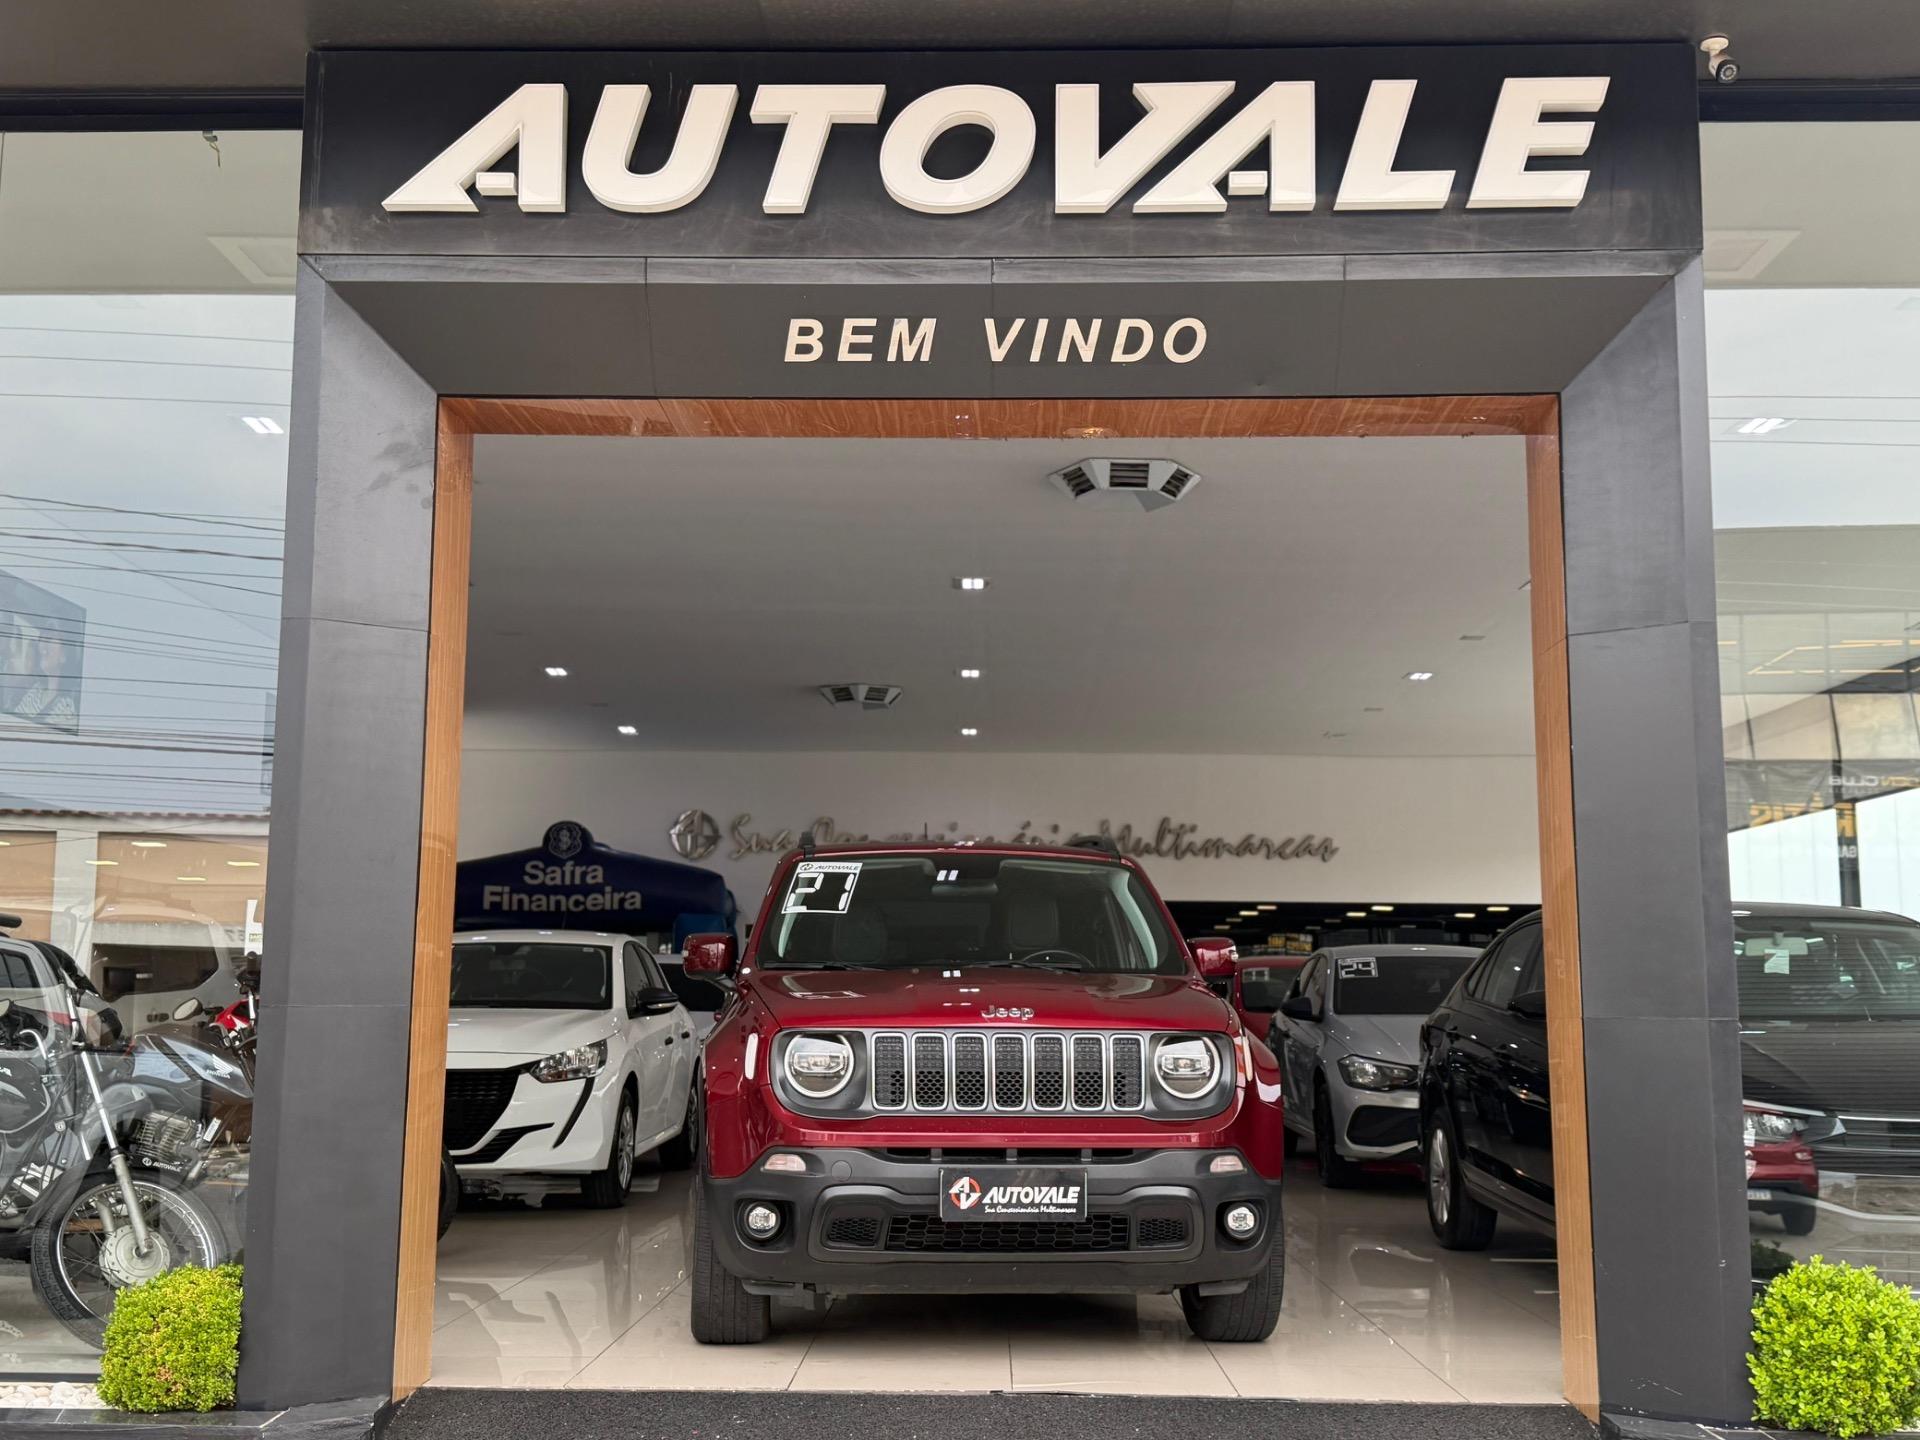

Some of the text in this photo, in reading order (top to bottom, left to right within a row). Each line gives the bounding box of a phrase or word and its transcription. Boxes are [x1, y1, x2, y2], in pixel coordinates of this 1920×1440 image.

[381, 77, 1610, 215] AUTOVALE
[784, 318, 1207, 364] BEM VINDO
[523, 860, 604, 886] Safra
[482, 885, 642, 912] Financeira
[786, 872, 855, 911] 21
[980, 1004, 1035, 1021] Jeep
[152, 1161, 182, 1172] AUTOVALE
[981, 1186, 1081, 1204] AUTOVALE
